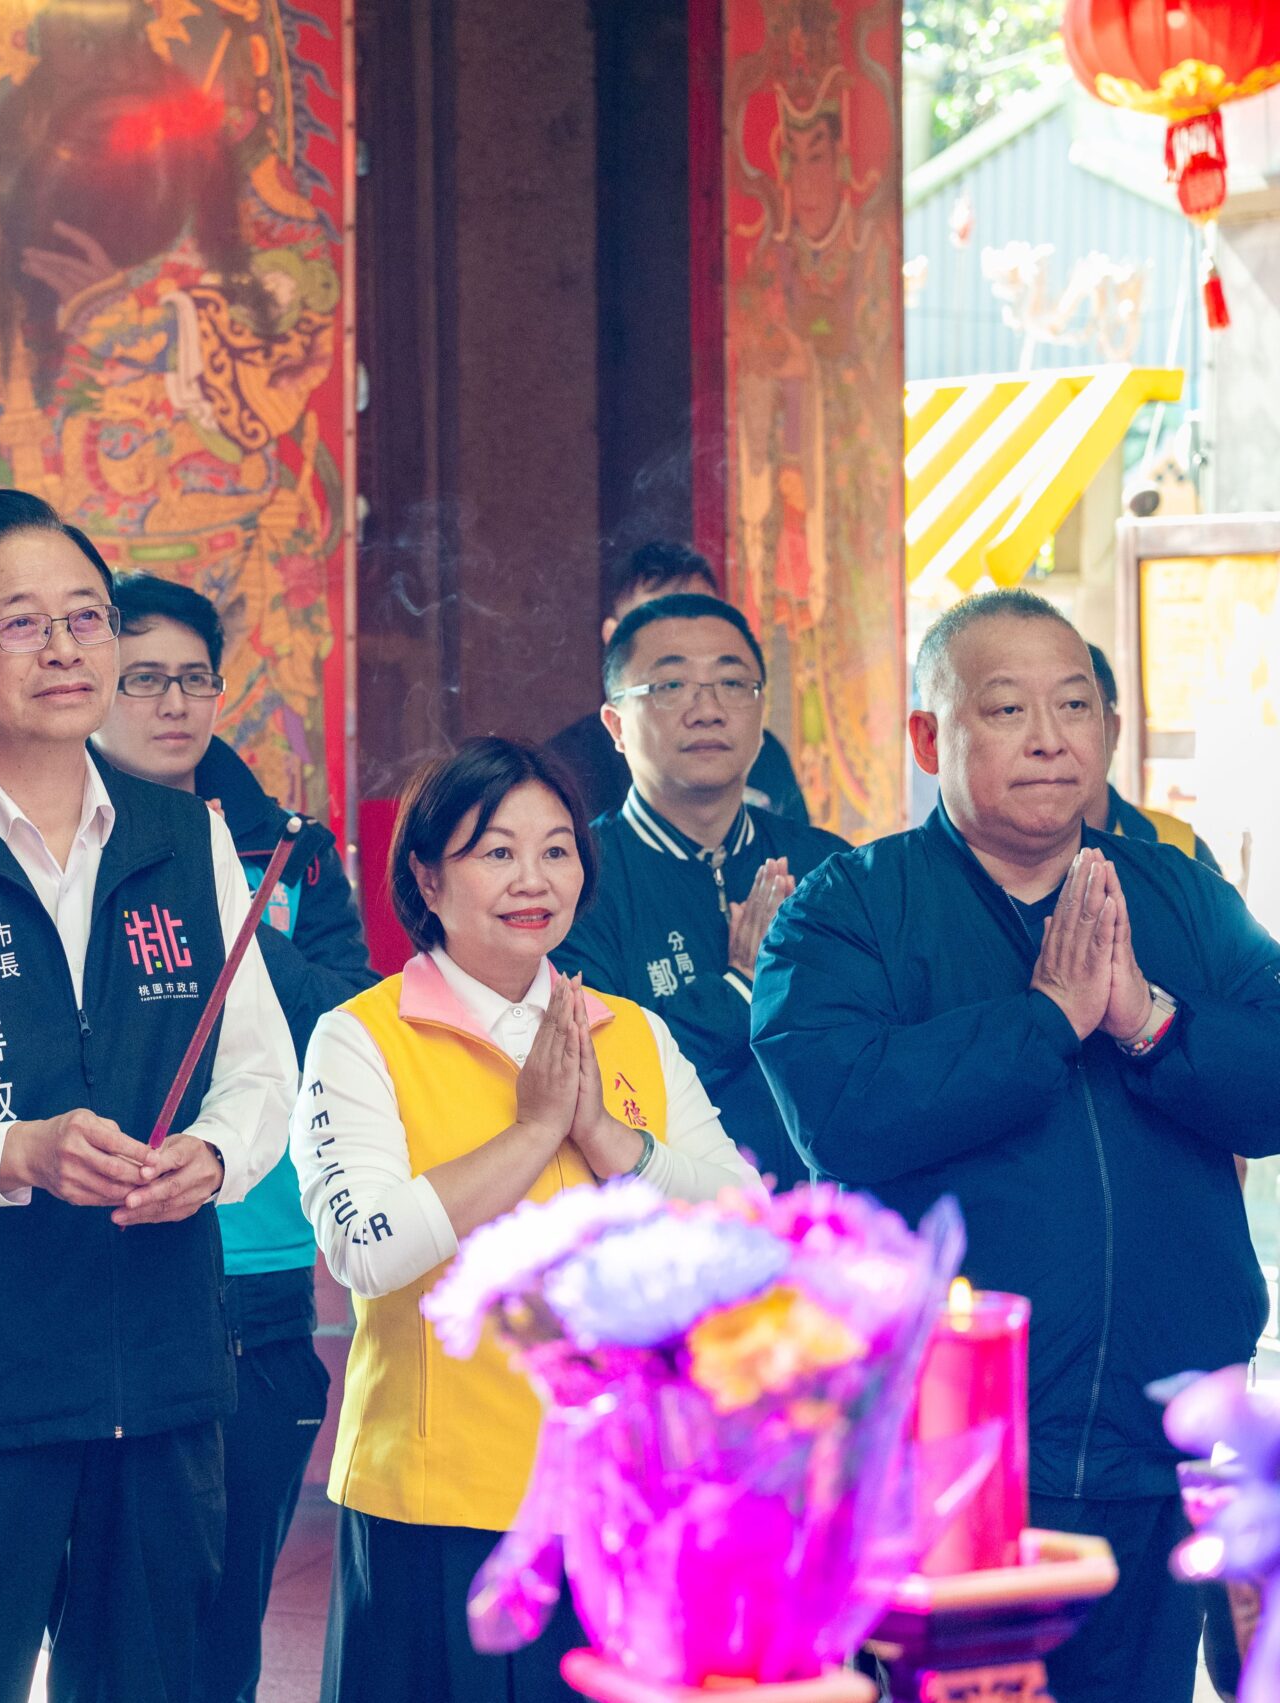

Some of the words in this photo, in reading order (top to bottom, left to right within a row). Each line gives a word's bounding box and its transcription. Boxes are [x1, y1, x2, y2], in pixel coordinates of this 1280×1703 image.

[647, 958, 678, 997] 鄭
[668, 931, 696, 984] 分局
[138, 981, 198, 997] 桃園市政府
[615, 1072, 647, 1127] 八德
